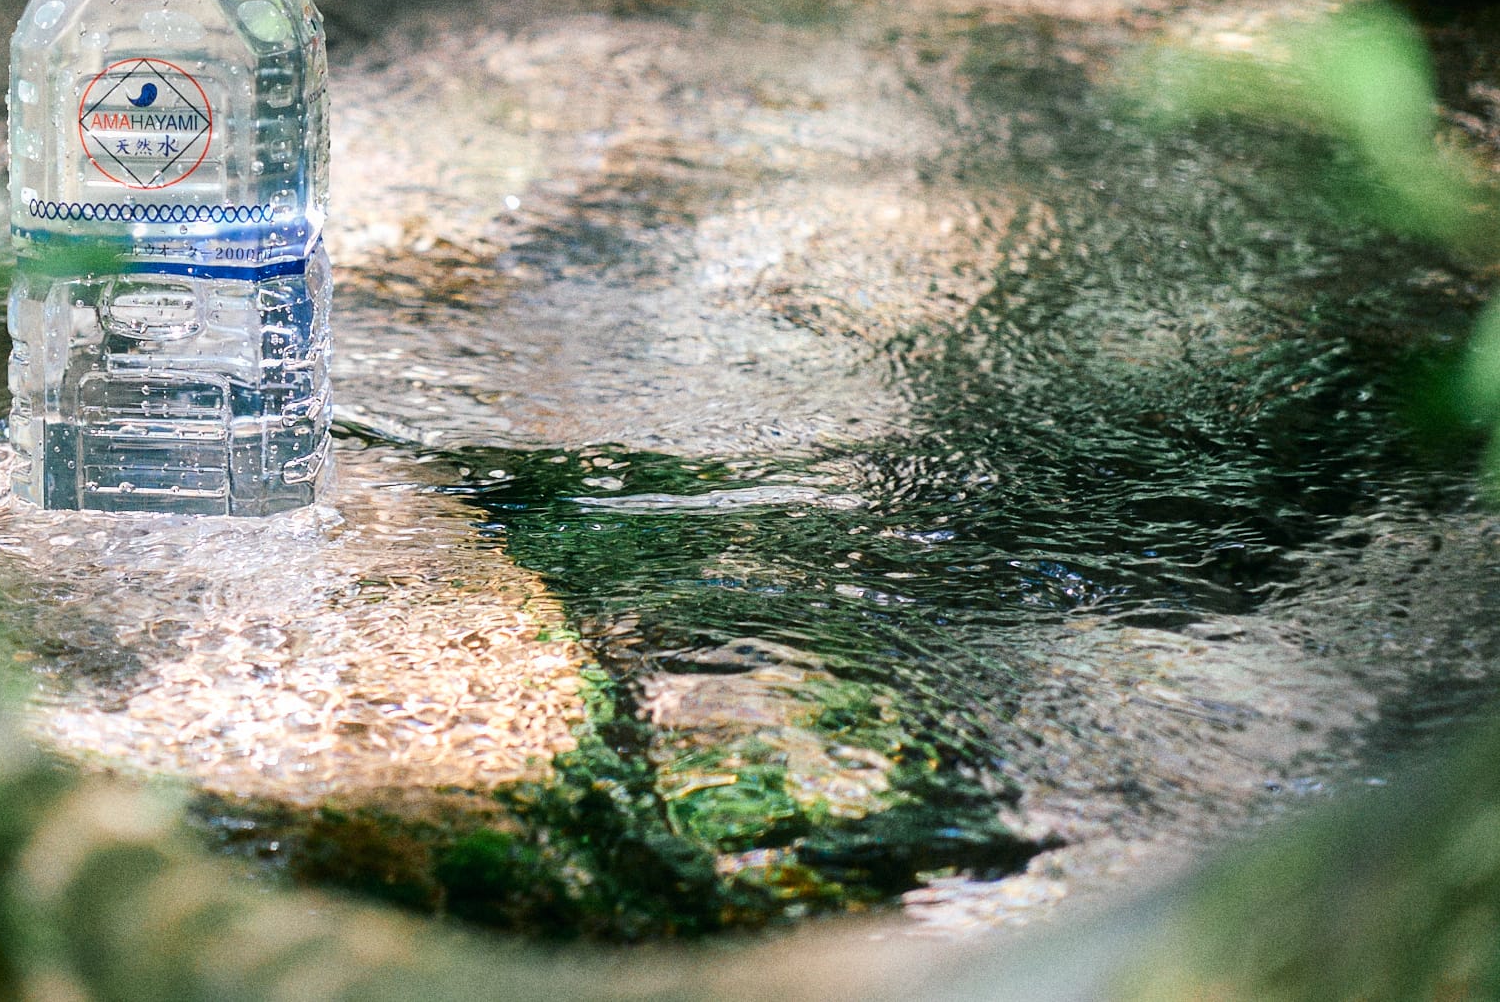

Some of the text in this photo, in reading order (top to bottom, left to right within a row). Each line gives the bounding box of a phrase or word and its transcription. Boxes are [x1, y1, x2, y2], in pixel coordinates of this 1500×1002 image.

[90, 112, 198, 131] AMAHAYAMI
[115, 134, 180, 158] 天然水
